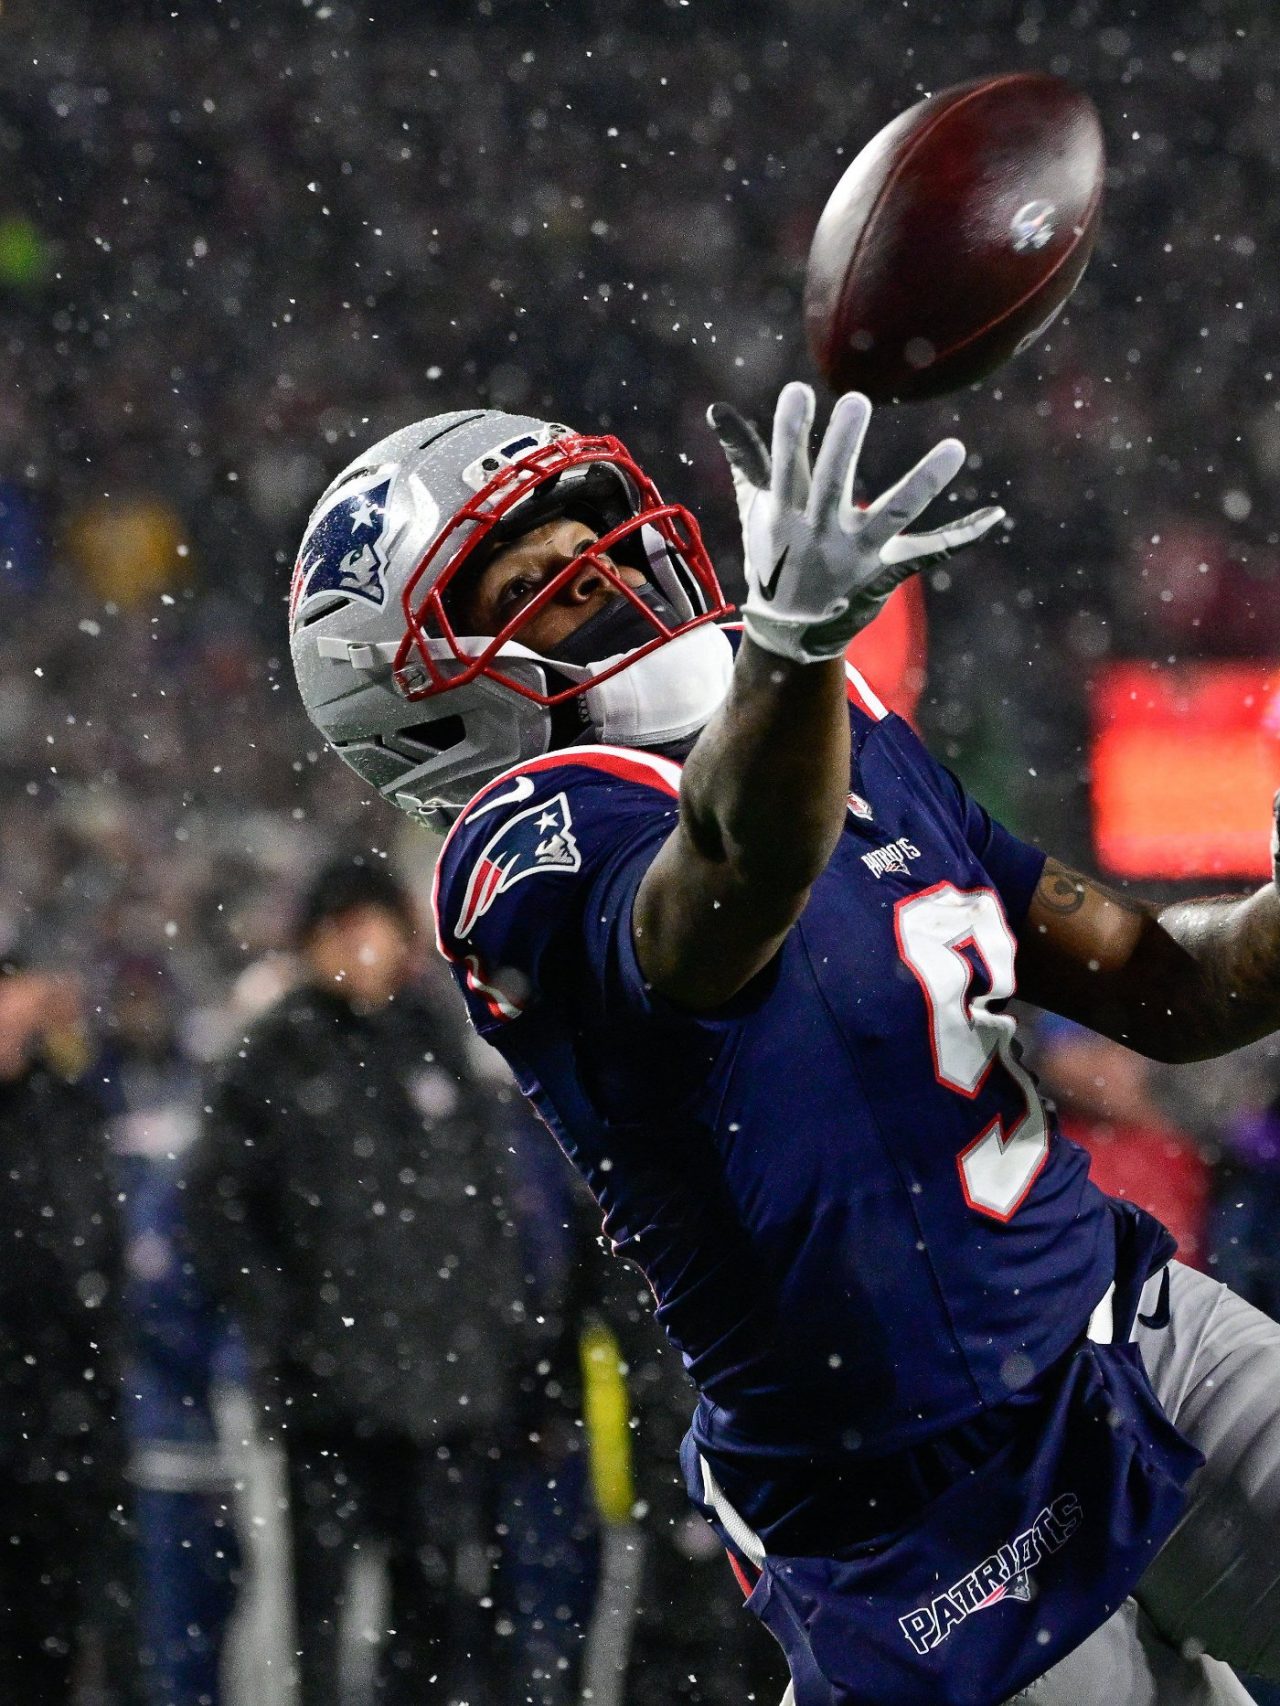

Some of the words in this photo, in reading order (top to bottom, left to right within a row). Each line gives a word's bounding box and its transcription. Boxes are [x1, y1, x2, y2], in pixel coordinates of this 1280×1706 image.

[861, 837, 921, 879] PATRIOTS
[894, 880, 1050, 1224] 9
[898, 1492, 1084, 1656] PATRIOTS
